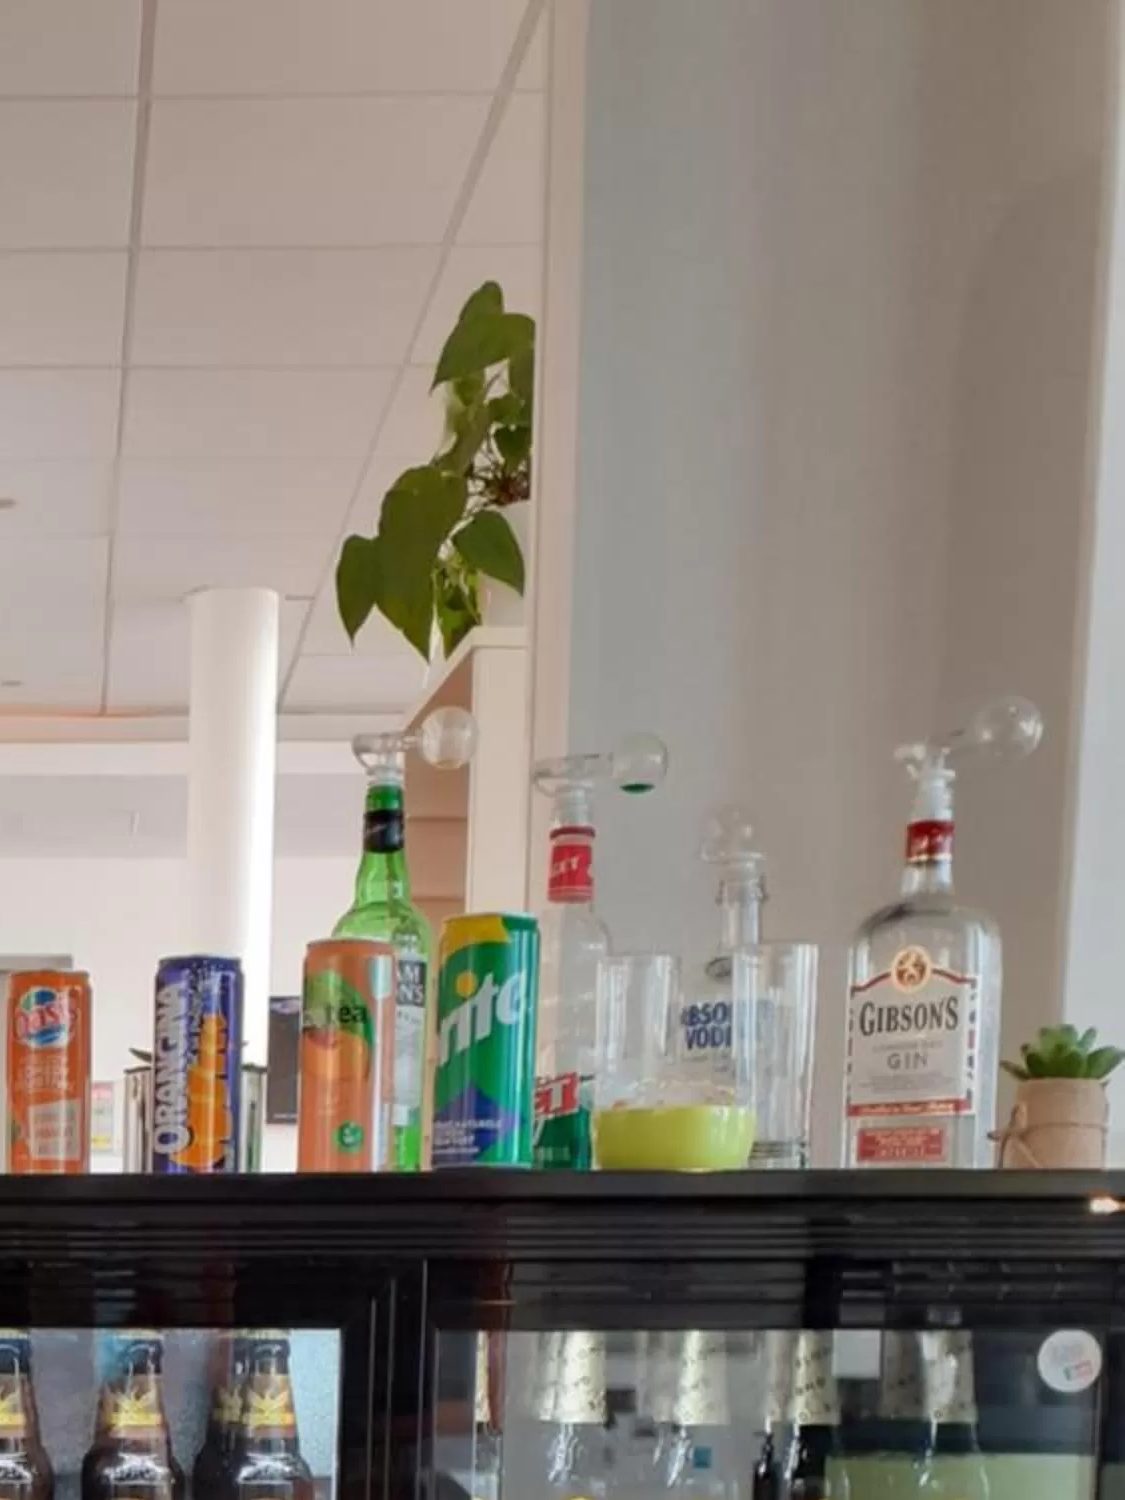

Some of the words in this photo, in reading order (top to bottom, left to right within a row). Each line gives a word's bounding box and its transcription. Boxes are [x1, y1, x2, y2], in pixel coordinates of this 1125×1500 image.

[859, 995, 960, 1038] GIBSON'S
[154, 982, 192, 1154] ORANGINA
[887, 1051, 928, 1070] GIN
